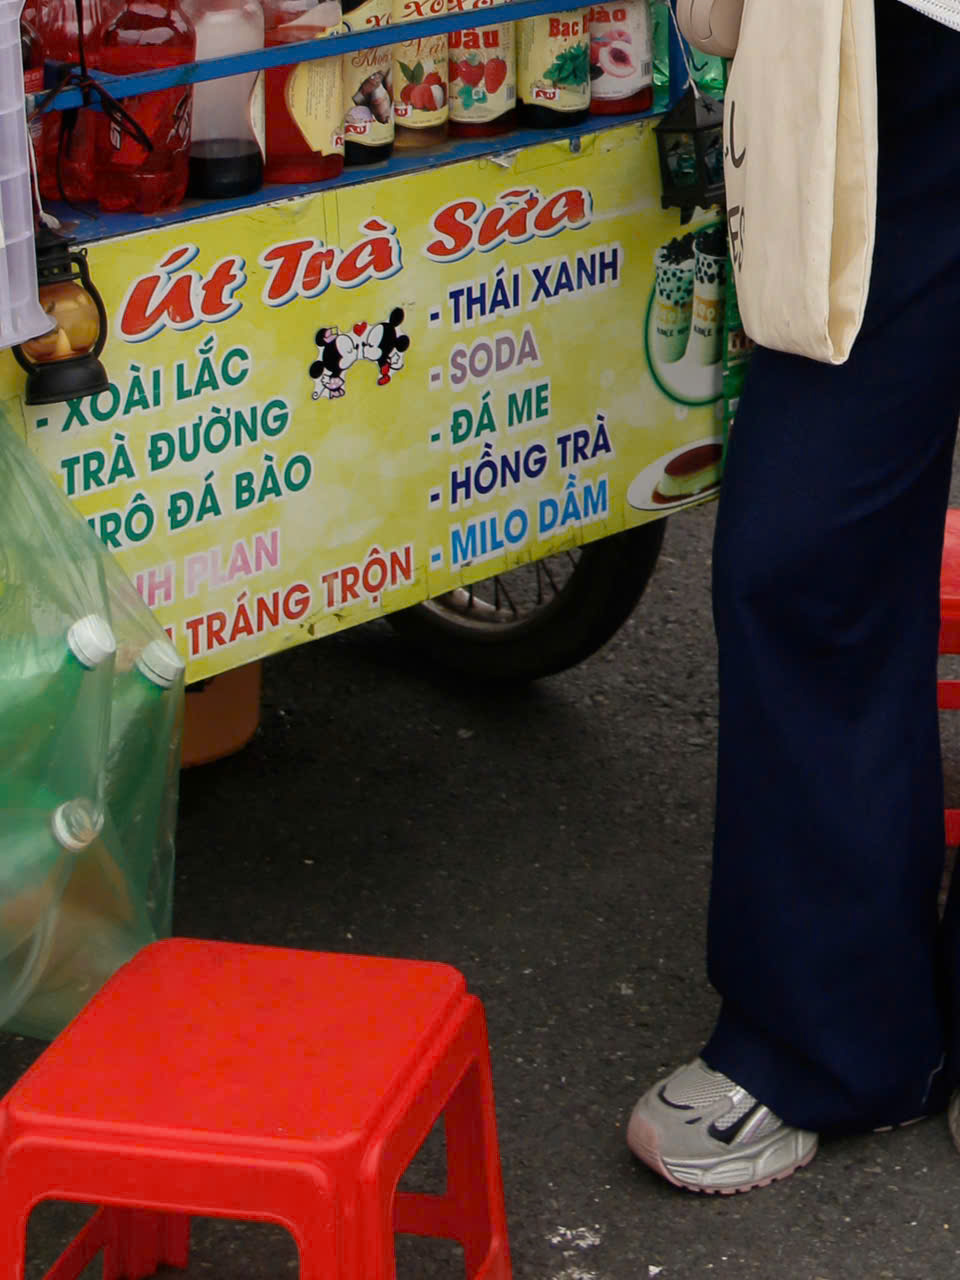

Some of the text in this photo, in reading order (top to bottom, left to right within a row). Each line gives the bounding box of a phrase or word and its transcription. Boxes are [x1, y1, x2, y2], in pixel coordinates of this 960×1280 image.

[120, 189, 586, 336] Út Trà Sữa
[449, 267, 519, 323] THÁI
[532, 248, 618, 302] XANH
[62, 365, 161, 431] XOÀI
[176, 337, 249, 400] LẮC
[451, 330, 538, 384] SODA
[61, 399, 289, 496] TRÀ ĐƯỜNG
[451, 391, 496, 444] ĐÁ
[508, 383, 549, 427] ME
[168, 471, 221, 530] ĐÁ
[236, 454, 312, 509] BÀO
[451, 443, 547, 504] HỒNG
[557, 414, 612, 468] TRÀ
[187, 531, 278, 595] PLAN
[451, 509, 528, 564] MILO
[539, 473, 607, 533] DẦM
[186, 583, 310, 655] TRÁNG
[322, 546, 411, 608] TRỘN
